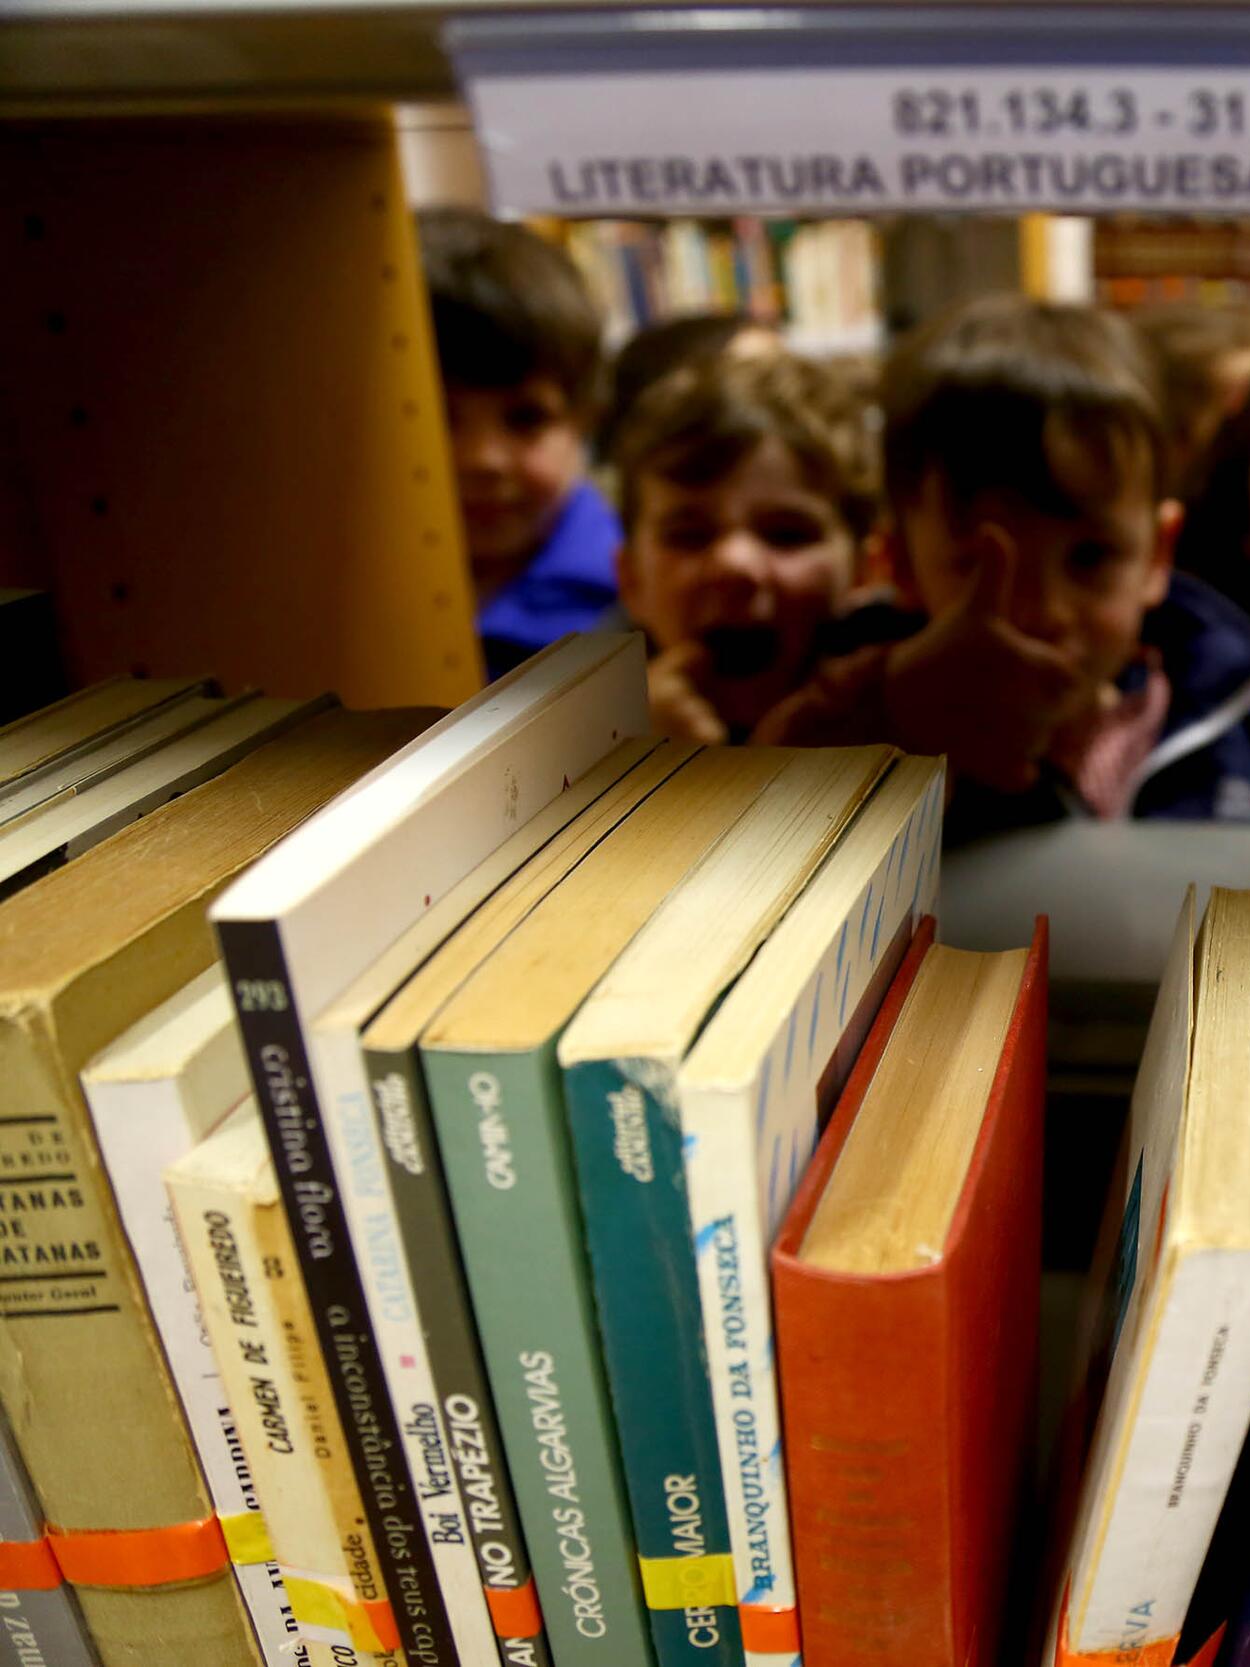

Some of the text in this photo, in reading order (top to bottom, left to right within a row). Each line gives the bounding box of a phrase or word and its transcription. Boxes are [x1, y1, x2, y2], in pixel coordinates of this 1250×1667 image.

[894, 91, 1138, 138] 821.134.3
[1190, 91, 1247, 138] 31
[550, 158, 885, 206] LITERATURA
[237, 979, 290, 1013] 293
[261, 1044, 334, 1260] cristina flora
[203, 1208, 260, 1328] FIGUEIREDO
[238, 1340, 270, 1366] DE
[712, 1213, 776, 1592] BRANQUINHO DA FONSECA
[249, 1377, 295, 1455] CARMEN
[332, 1332, 406, 1510] inconstância
[384, 1514, 414, 1561] dos
[399, 1563, 428, 1617] teus
[405, 1403, 467, 1546] Boi Vermelho
[445, 1393, 518, 1588] NO TRAPÉZIO
[518, 1350, 608, 1640] CRÓNICAS ALGARVIAS
[662, 1473, 707, 1559] MAIOR
[342, 1532, 380, 1602] cidade
